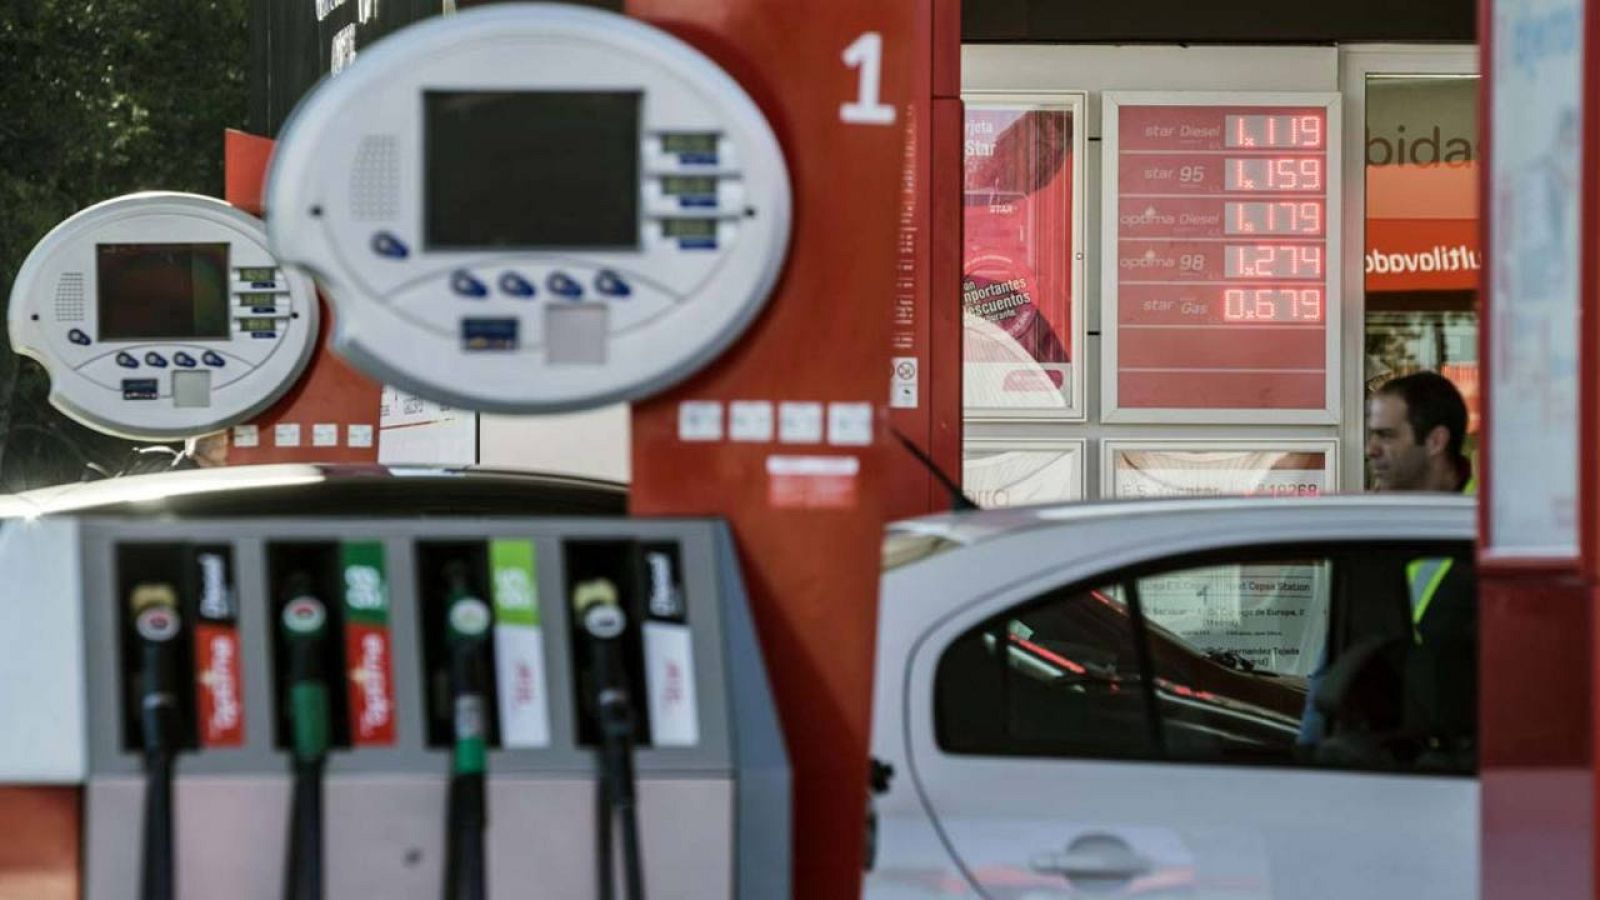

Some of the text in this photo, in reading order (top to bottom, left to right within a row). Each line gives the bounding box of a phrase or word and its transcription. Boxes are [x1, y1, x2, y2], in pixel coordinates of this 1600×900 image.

[840, 32, 896, 124] 1
[1145, 126, 1175, 137] star
[1180, 124, 1220, 137] Diesel
[1366, 125, 1473, 169] bida
[1144, 168, 1173, 179] star
[1180, 166, 1205, 182] 95
[1180, 213, 1219, 226] Diesel
[1180, 254, 1205, 271] 98
[1144, 300, 1174, 311] star
[1181, 302, 1208, 315] Gas
